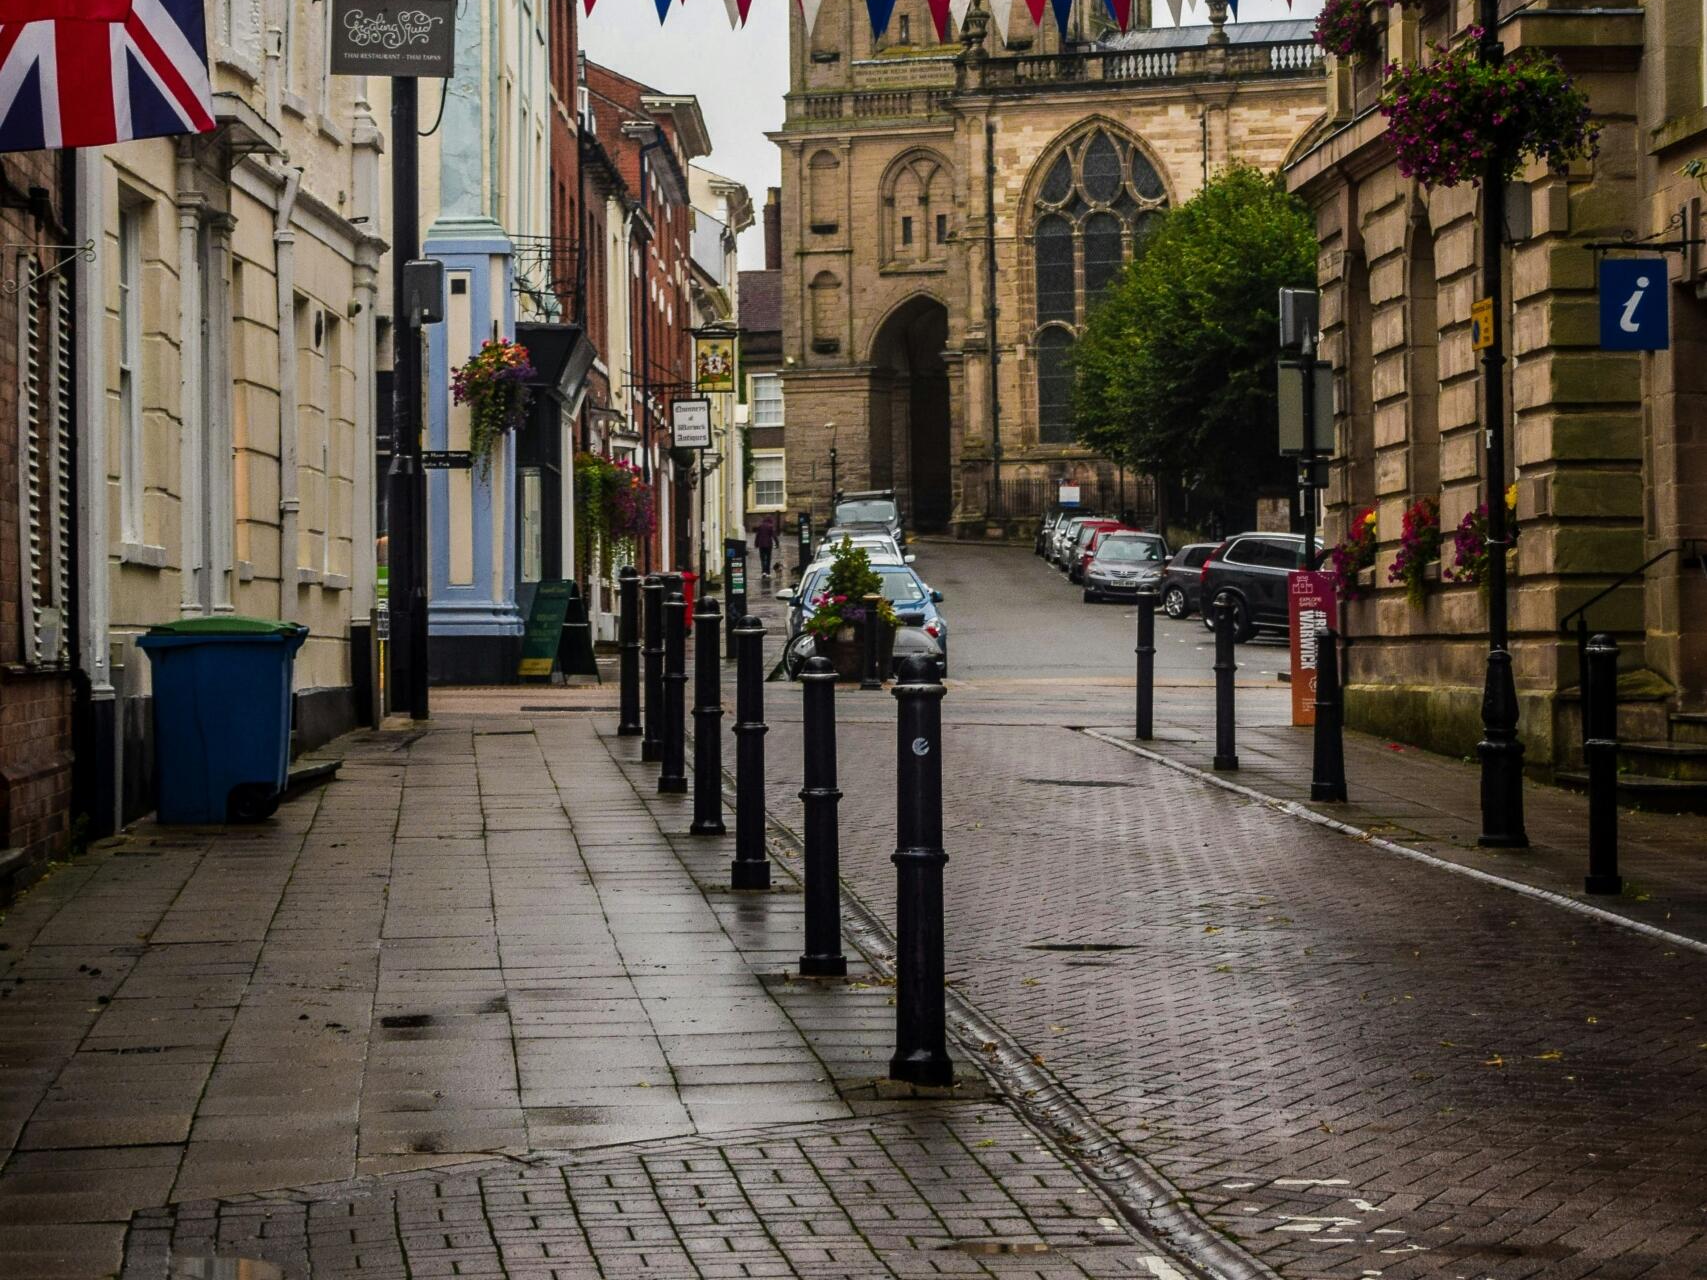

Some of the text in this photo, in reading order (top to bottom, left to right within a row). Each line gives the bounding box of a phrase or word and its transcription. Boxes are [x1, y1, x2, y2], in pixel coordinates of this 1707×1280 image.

[344, 9, 443, 48] Giggling Squid
[360, 52, 400, 60] RESTAURANT
[1299, 610, 1316, 669] WARWICK
